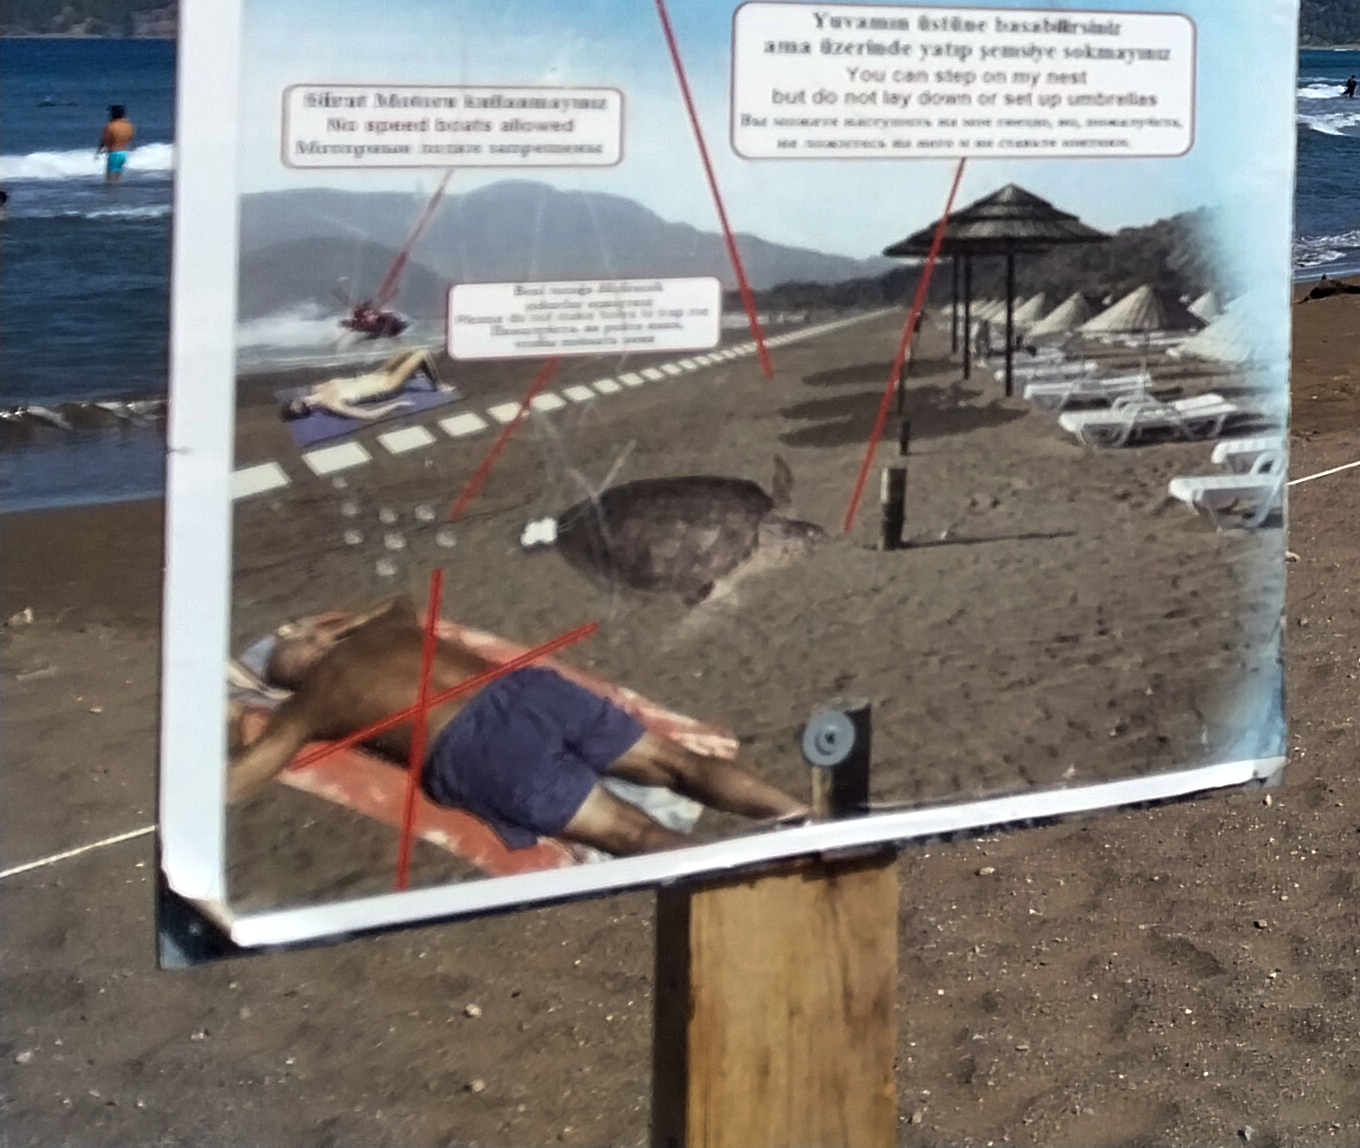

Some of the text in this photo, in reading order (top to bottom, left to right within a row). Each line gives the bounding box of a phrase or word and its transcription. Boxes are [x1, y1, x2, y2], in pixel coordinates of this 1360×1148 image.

[813, 10, 910, 30] Yuvamın
[764, 39, 812, 55] ama
[846, 66, 1087, 87] You can step on my nest
[771, 88, 1159, 109] but do not lay down or set up umbrellas
[365, 117, 431, 135] speed
[499, 117, 576, 133] allowed
